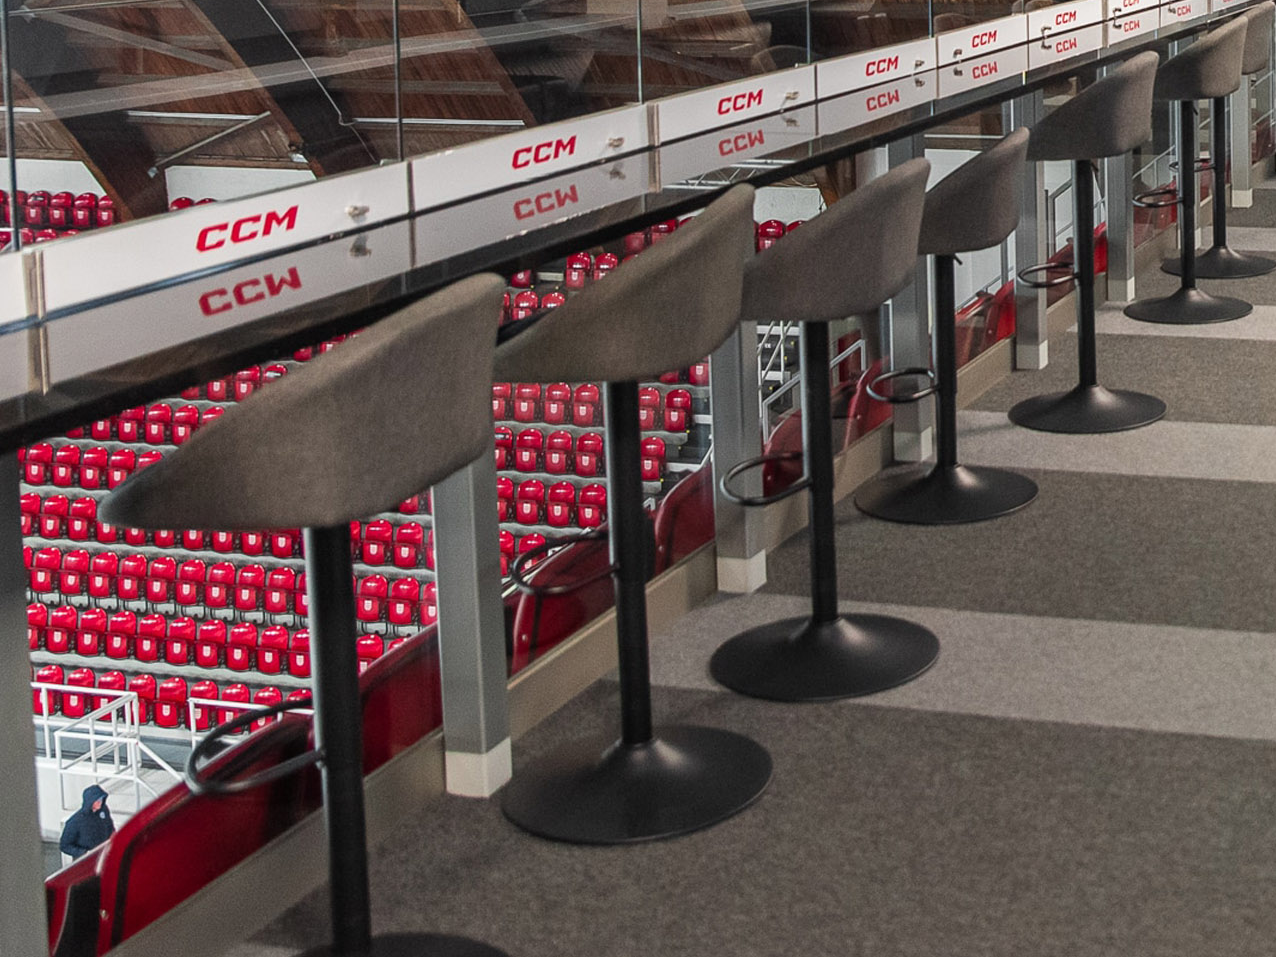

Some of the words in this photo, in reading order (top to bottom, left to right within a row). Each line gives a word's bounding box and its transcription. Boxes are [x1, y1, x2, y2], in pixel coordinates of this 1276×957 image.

[1055, 10, 1078, 27] CCM
[971, 29, 998, 49] CCM
[864, 54, 900, 77] CCM
[717, 88, 764, 117] CCM
[510, 134, 577, 171] CCM
[195, 204, 300, 252] CCM
